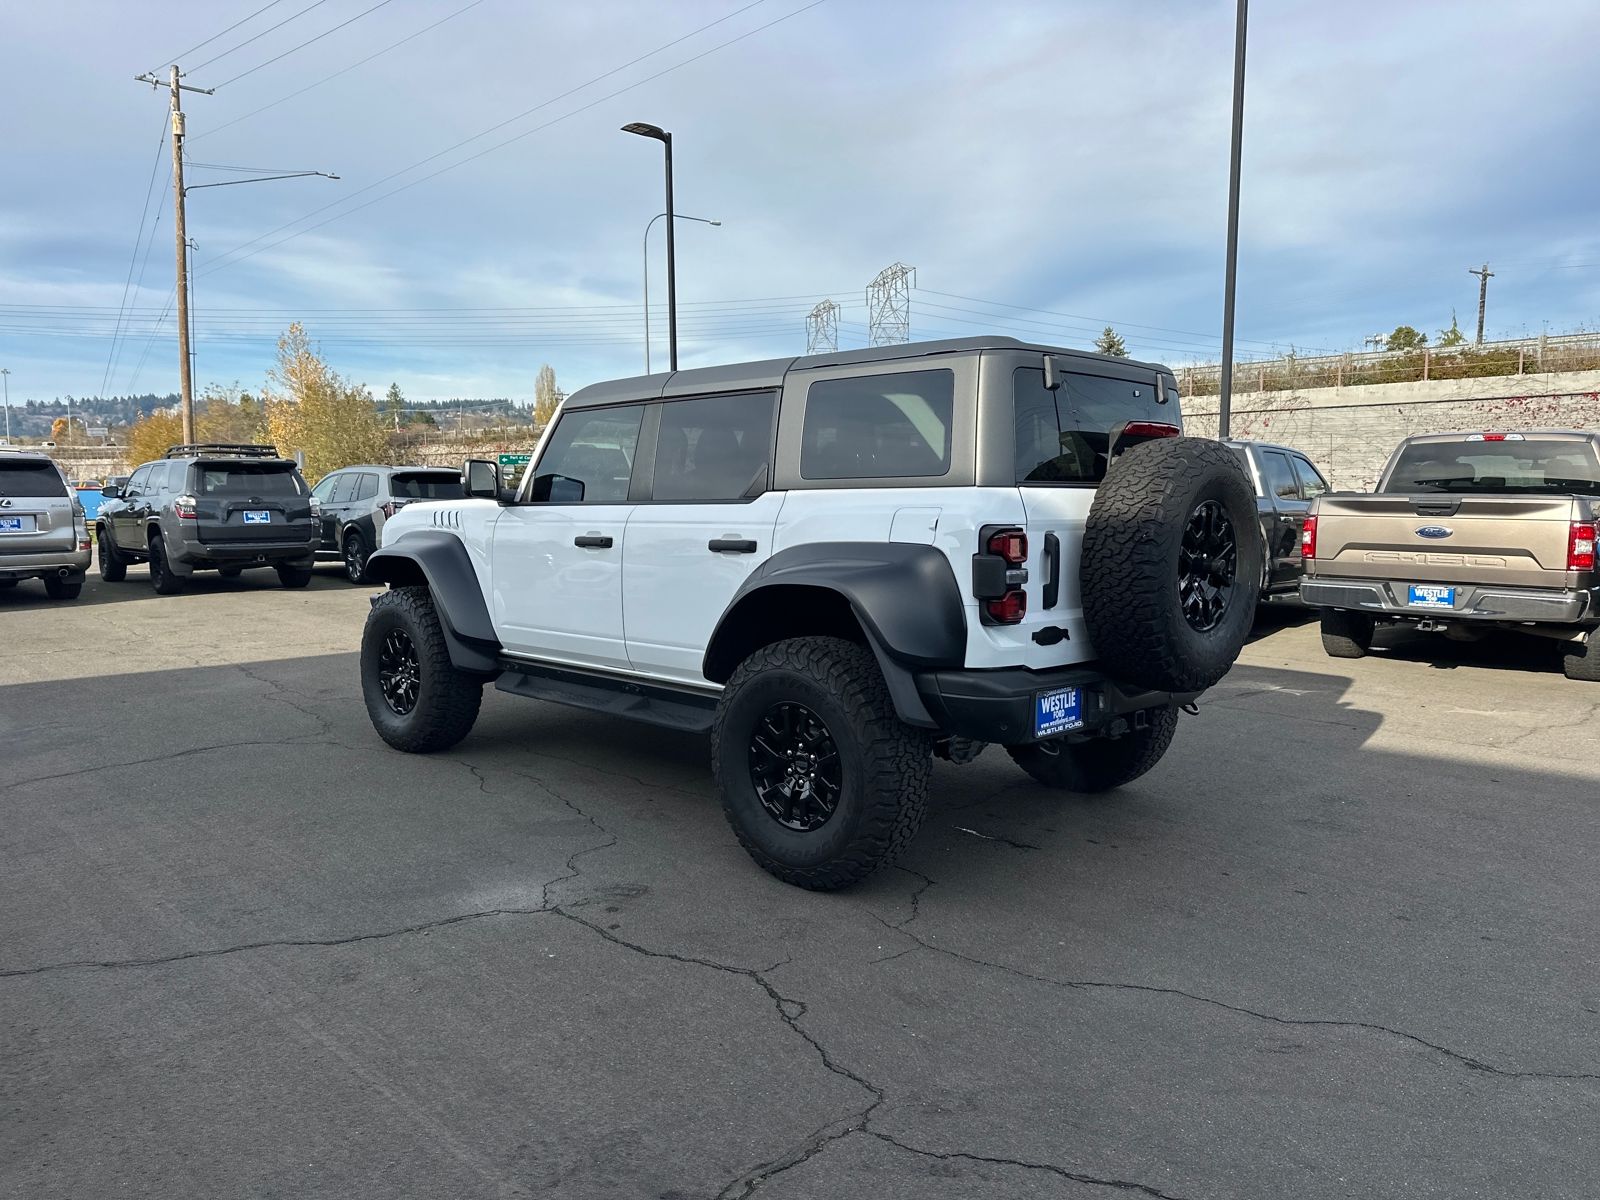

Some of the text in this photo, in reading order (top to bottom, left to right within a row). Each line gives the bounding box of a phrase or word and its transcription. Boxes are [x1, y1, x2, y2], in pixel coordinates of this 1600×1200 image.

[1364, 551, 1507, 569] F-150
[1414, 588, 1450, 599] WESTLIE
[1041, 691, 1076, 714] WESTLIE
[1053, 709, 1066, 720] FORD
